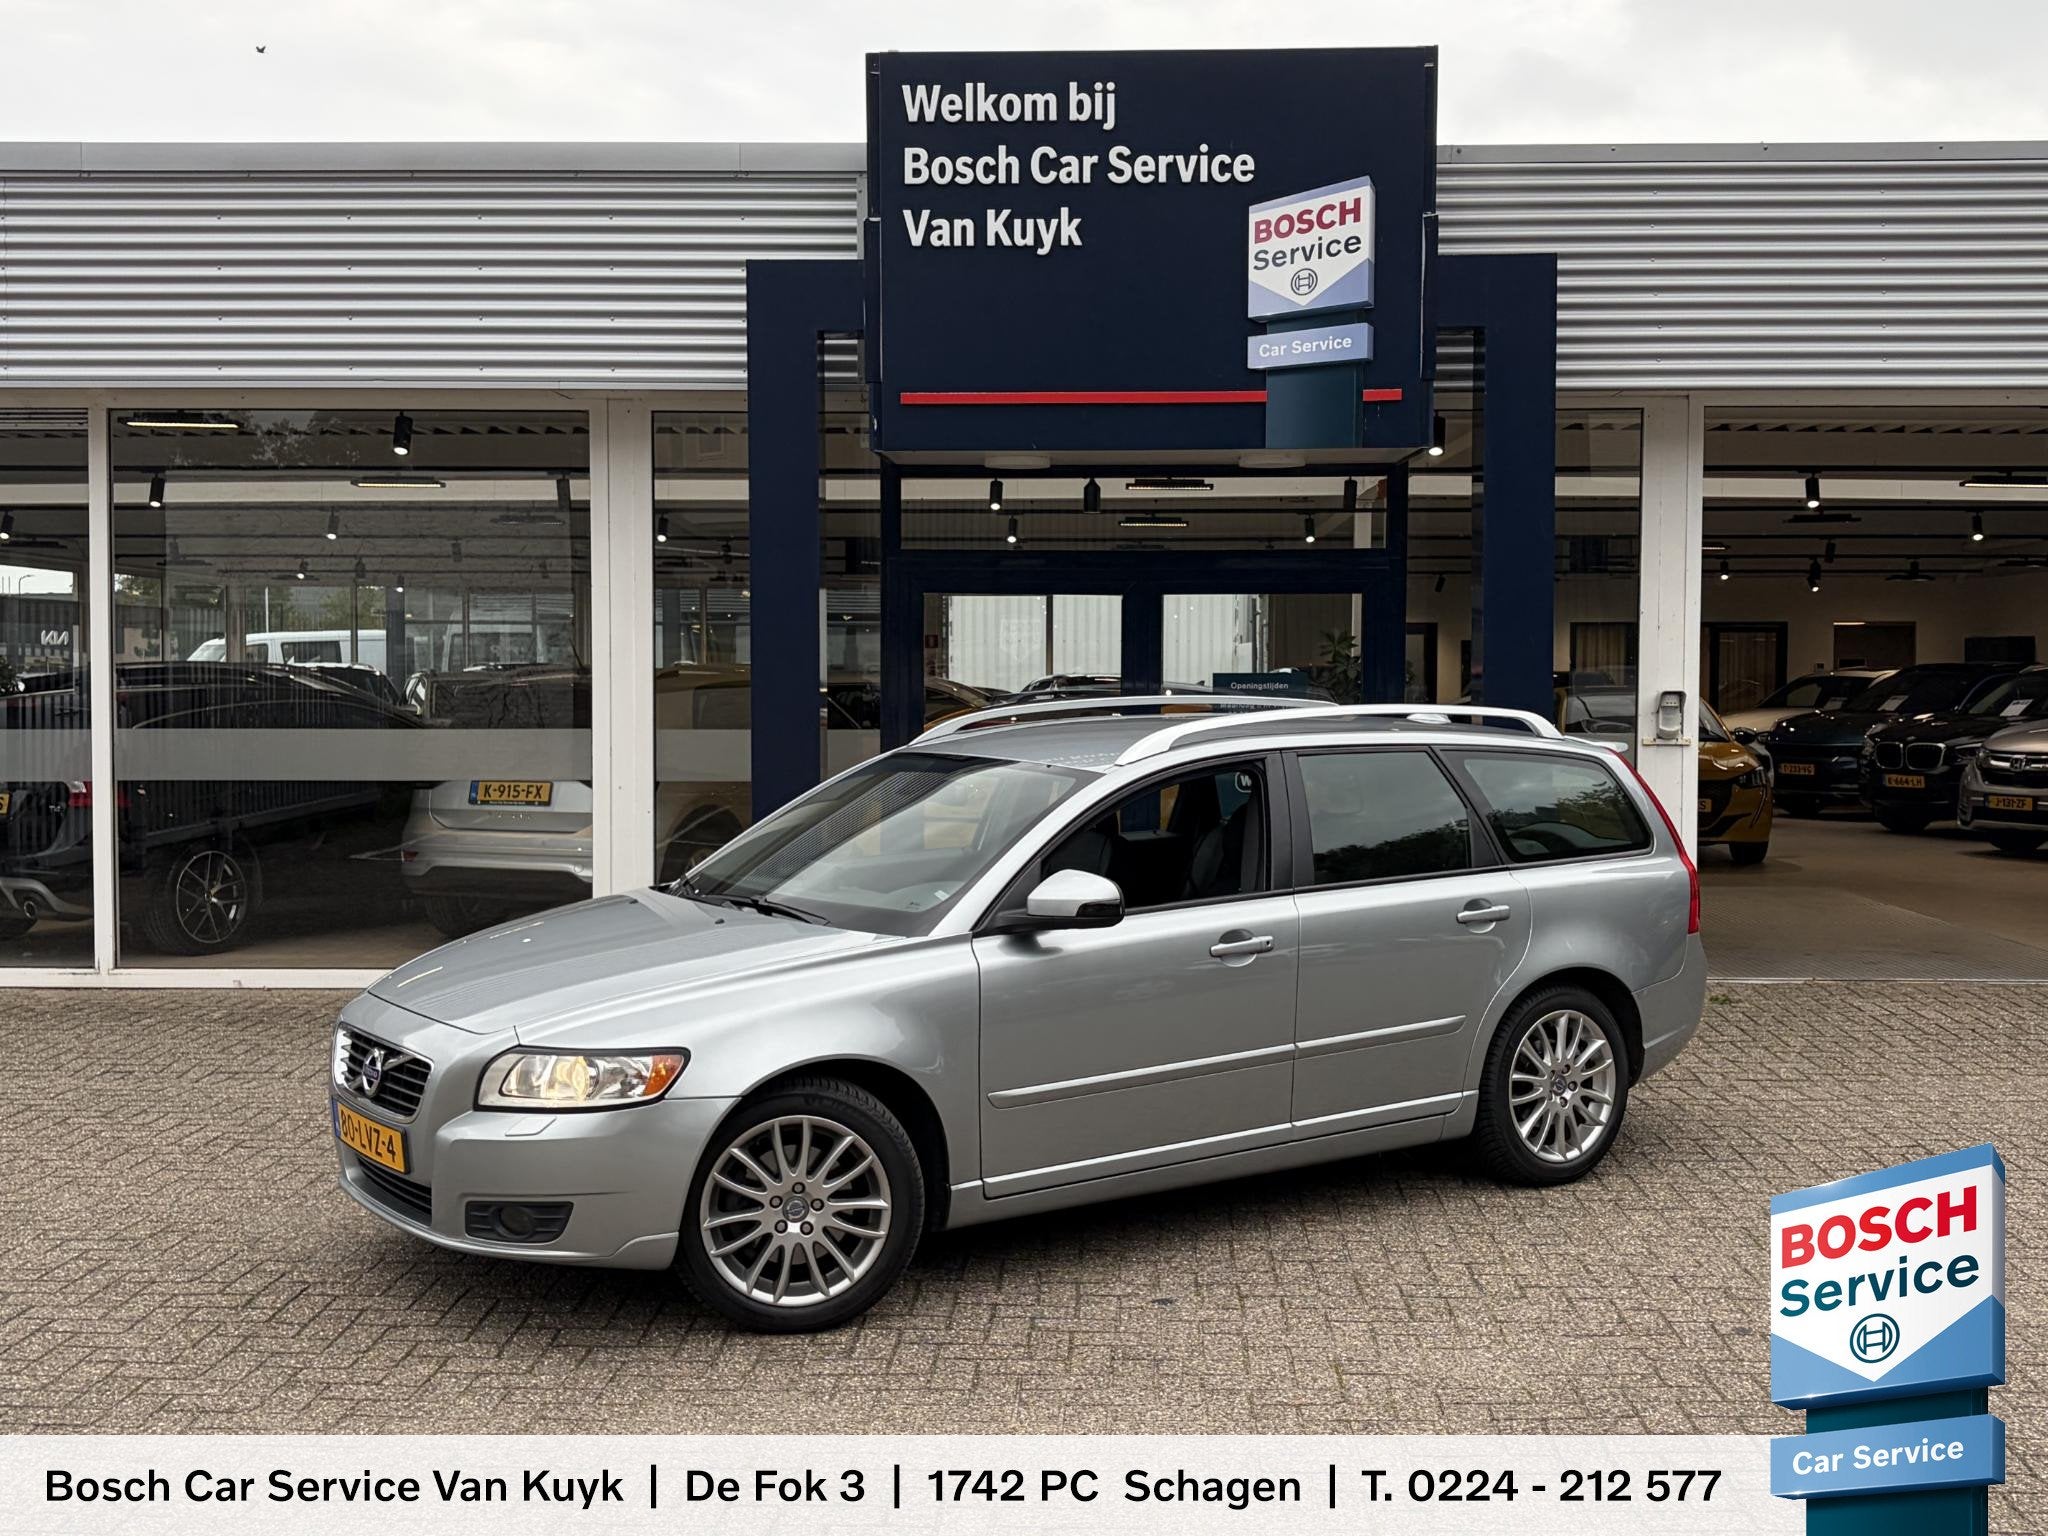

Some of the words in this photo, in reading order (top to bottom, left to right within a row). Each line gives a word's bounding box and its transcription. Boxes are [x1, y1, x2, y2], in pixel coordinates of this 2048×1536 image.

[901, 82, 1058, 123] Welkom
[1069, 81, 1117, 130] bij
[903, 144, 1020, 185] Bosch
[1030, 145, 1099, 184] Car
[1107, 143, 1256, 183] Service
[902, 209, 975, 247] Van
[986, 206, 1083, 256] Kuyk
[1254, 197, 1361, 244] BOSCH
[1253, 235, 1362, 271] Service
[1259, 344, 1287, 358] Car
[1292, 336, 1352, 354] Service
[1230, 682, 1289, 691] Openingstijden
[483, 783, 544, 799] K-915-FX
[340, 1109, 396, 1163] 80-LVZ-4
